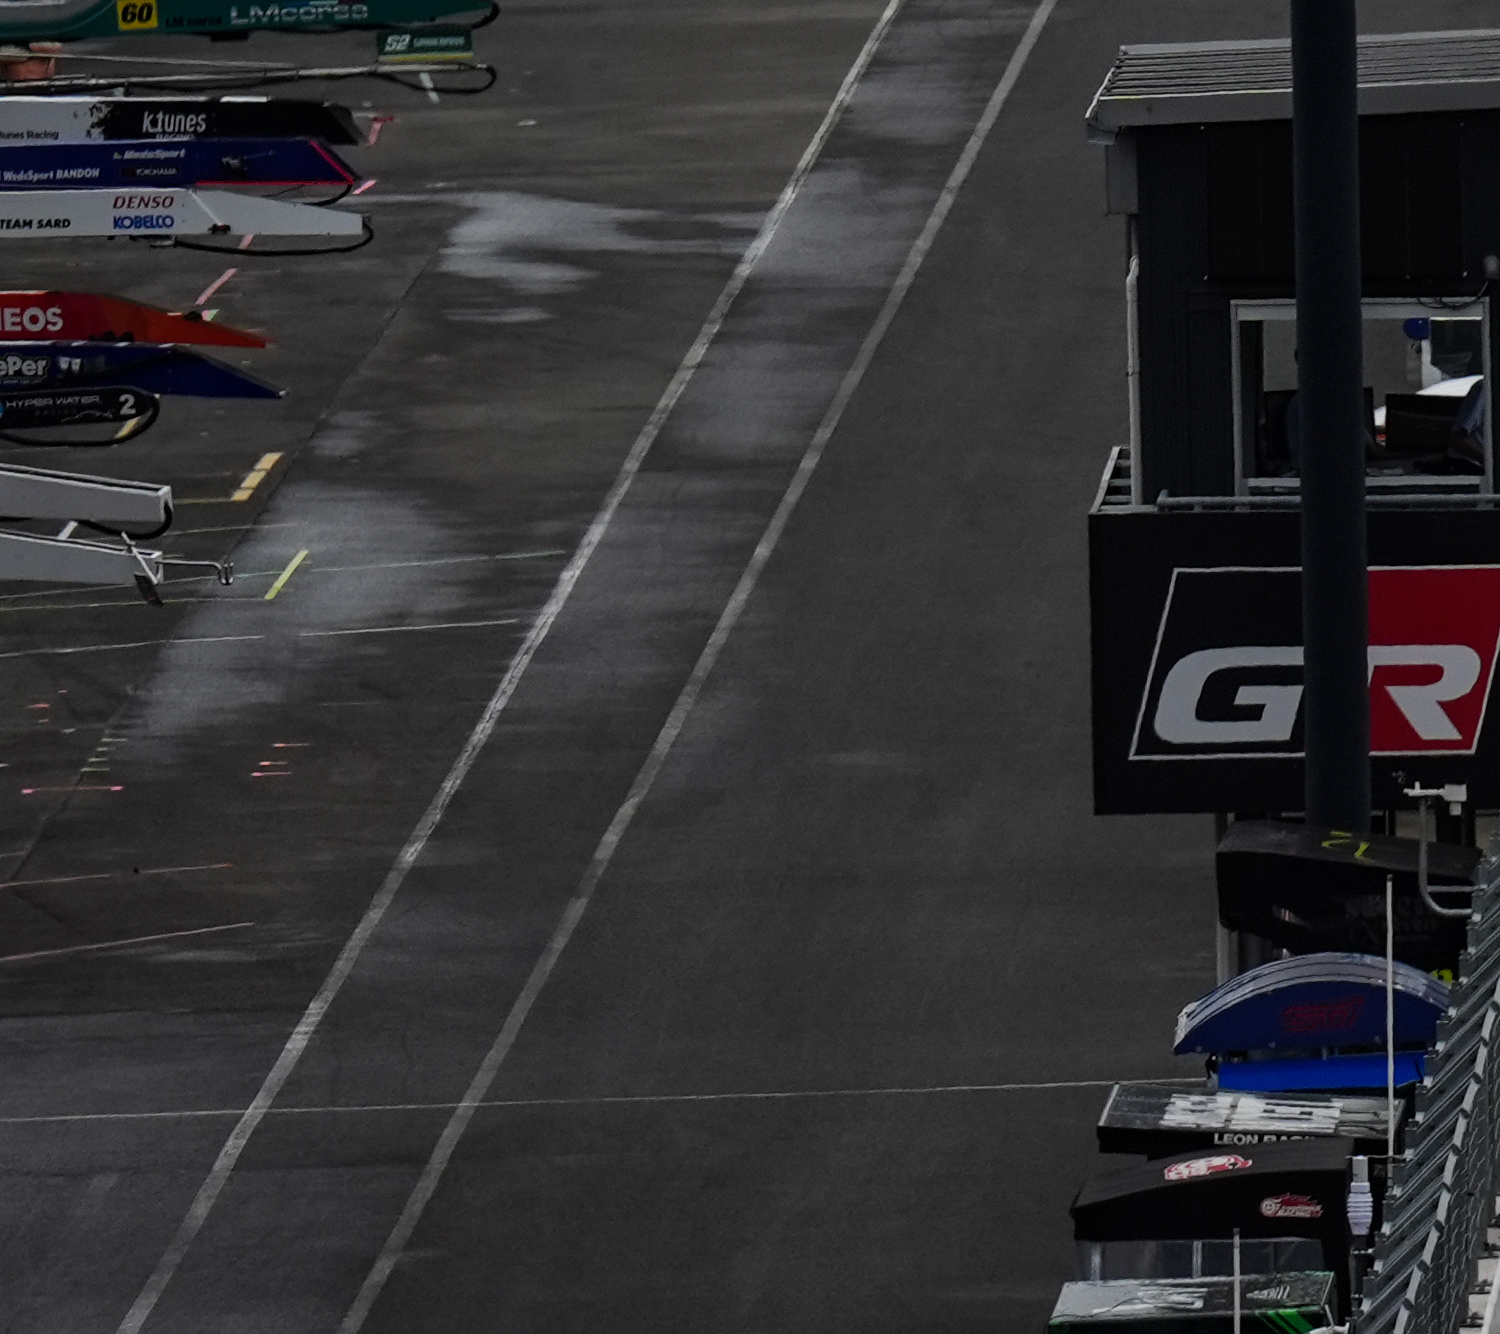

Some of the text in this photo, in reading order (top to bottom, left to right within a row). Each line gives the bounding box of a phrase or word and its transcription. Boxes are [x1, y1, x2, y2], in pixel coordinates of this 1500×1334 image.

[121, 3, 153, 24] 60
[27, 130, 59, 141] Racing
[56, 167, 101, 180] BANDOH
[113, 195, 175, 209] DENSO
[36, 218, 71, 230] SARD
[113, 214, 175, 230] KOBELCO
[0, 306, 64, 333] EOS
[119, 394, 137, 415] 2
[1154, 643, 1482, 745] GR
[1213, 1132, 1260, 1147] LEON
